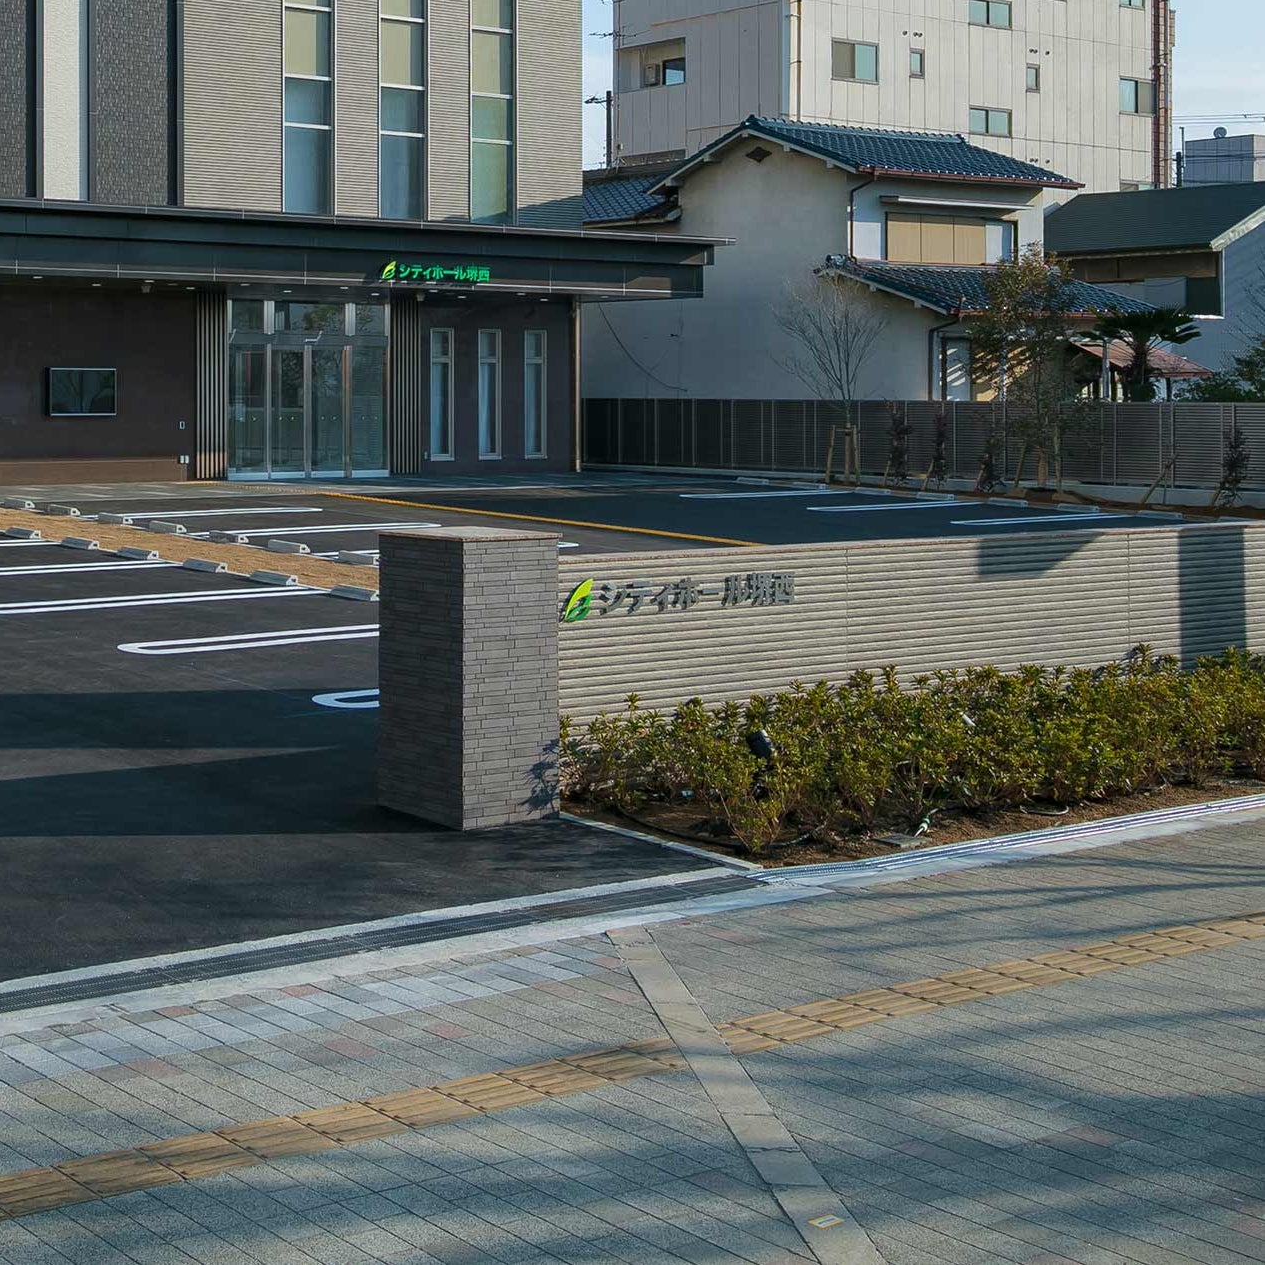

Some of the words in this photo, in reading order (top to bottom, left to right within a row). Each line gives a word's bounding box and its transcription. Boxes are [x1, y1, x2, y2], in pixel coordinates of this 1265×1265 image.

[399, 264, 491, 282] シティホール堺西
[599, 572, 795, 615] シティホール堺西
